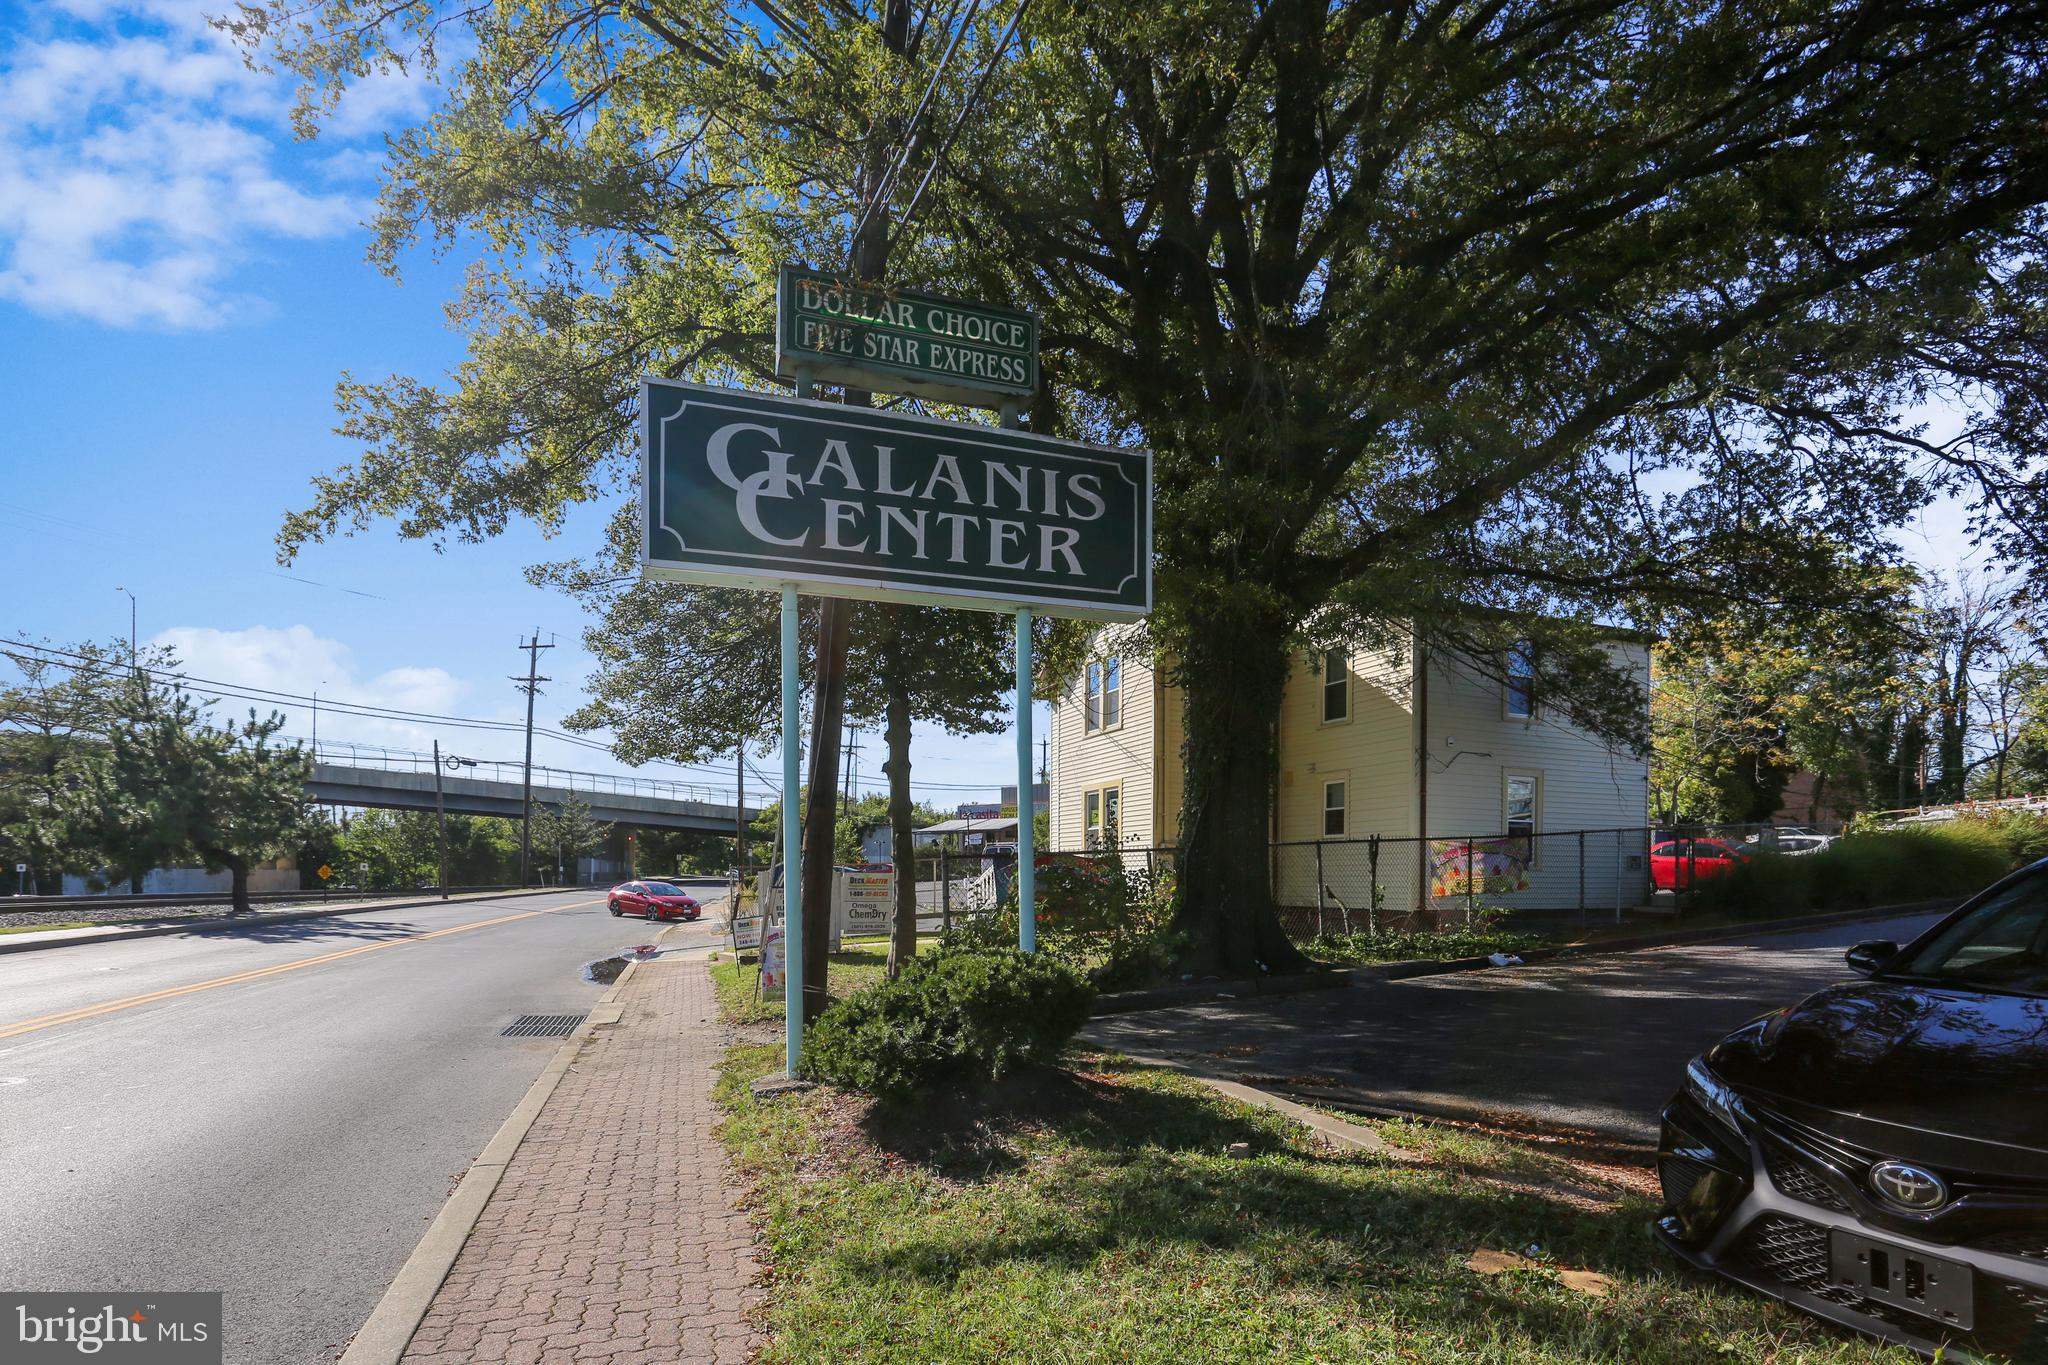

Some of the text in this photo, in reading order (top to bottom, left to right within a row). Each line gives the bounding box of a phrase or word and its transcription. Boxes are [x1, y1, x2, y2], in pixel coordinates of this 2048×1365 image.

[802, 285, 1025, 349] DOLLAR CHOICE
[863, 332, 920, 366] STAR
[930, 343, 1026, 383] EXPRESS
[706, 422, 1106, 521] GALANIS
[736, 470, 1087, 576] CENTER
[851, 902, 877, 910] Omega
